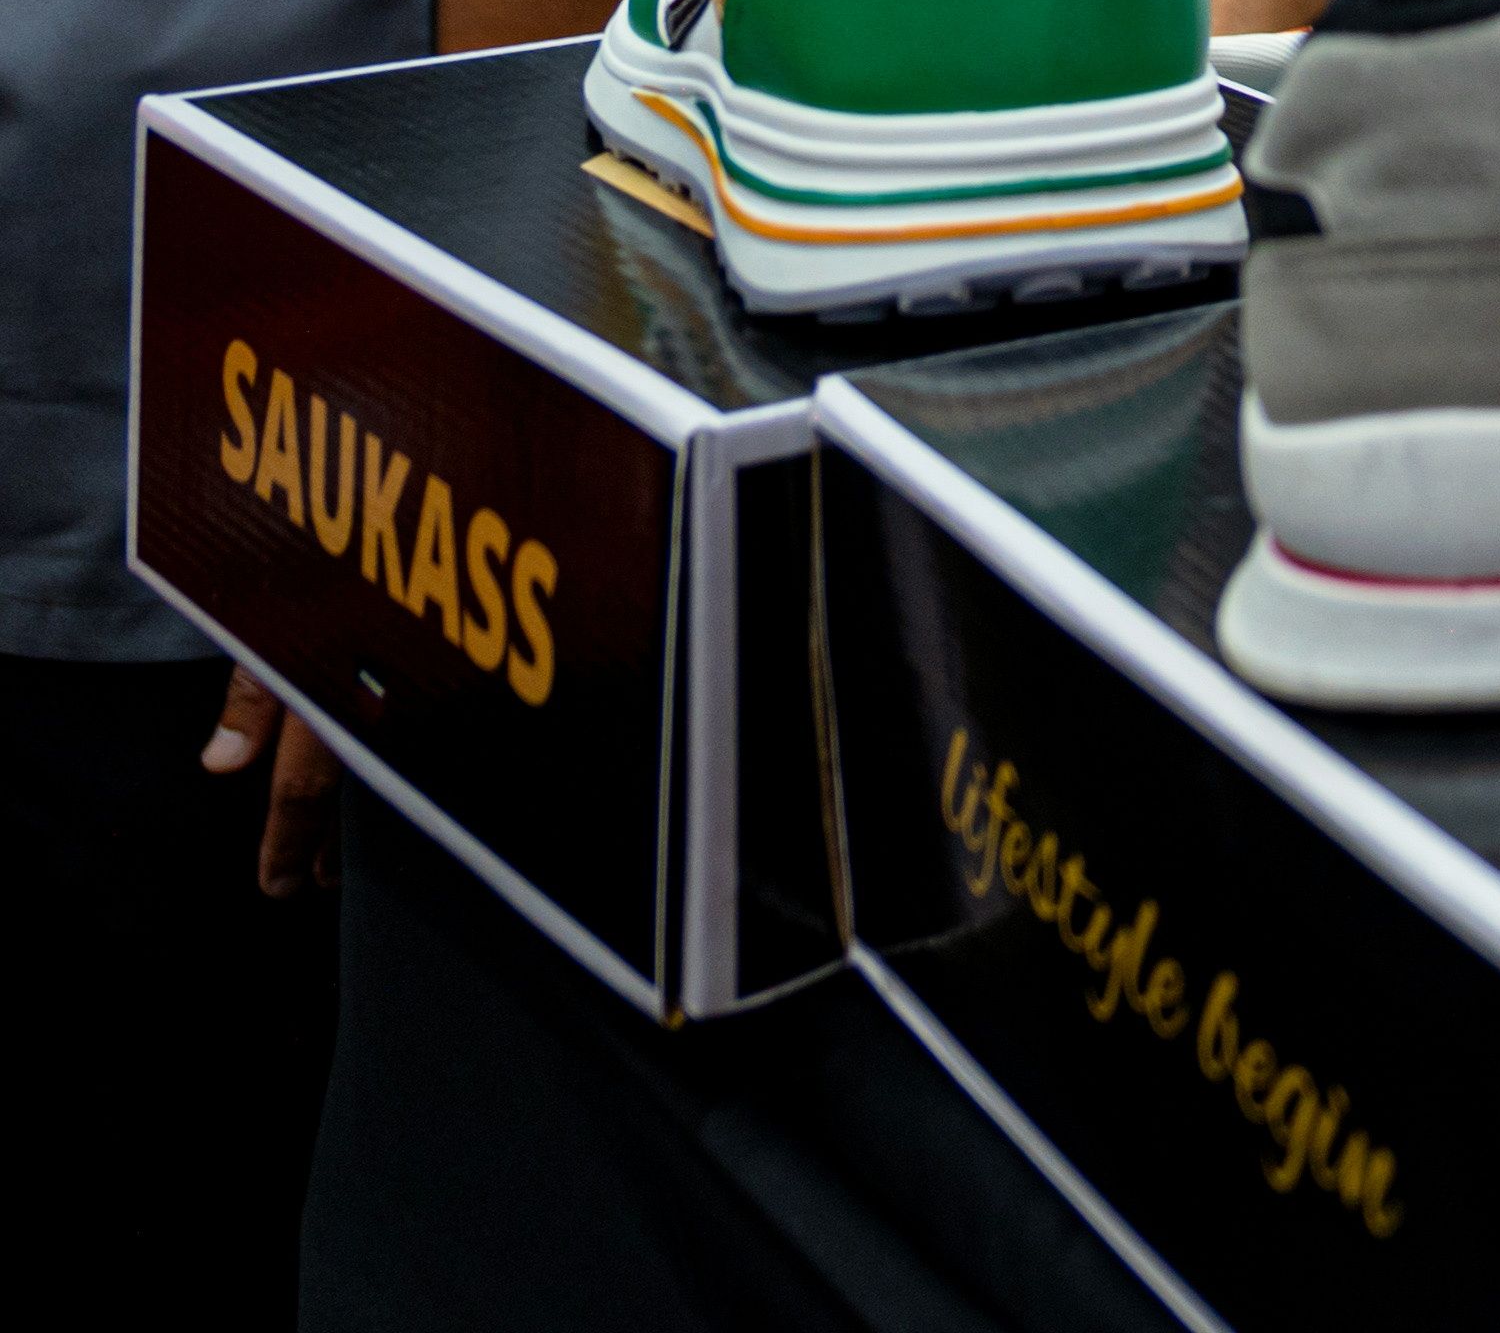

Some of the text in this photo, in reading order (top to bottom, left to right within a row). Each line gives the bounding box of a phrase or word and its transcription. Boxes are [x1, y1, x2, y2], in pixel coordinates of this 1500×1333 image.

[218, 338, 559, 707] SAUKASS
[939, 727, 1403, 1238] lifestyle begin
